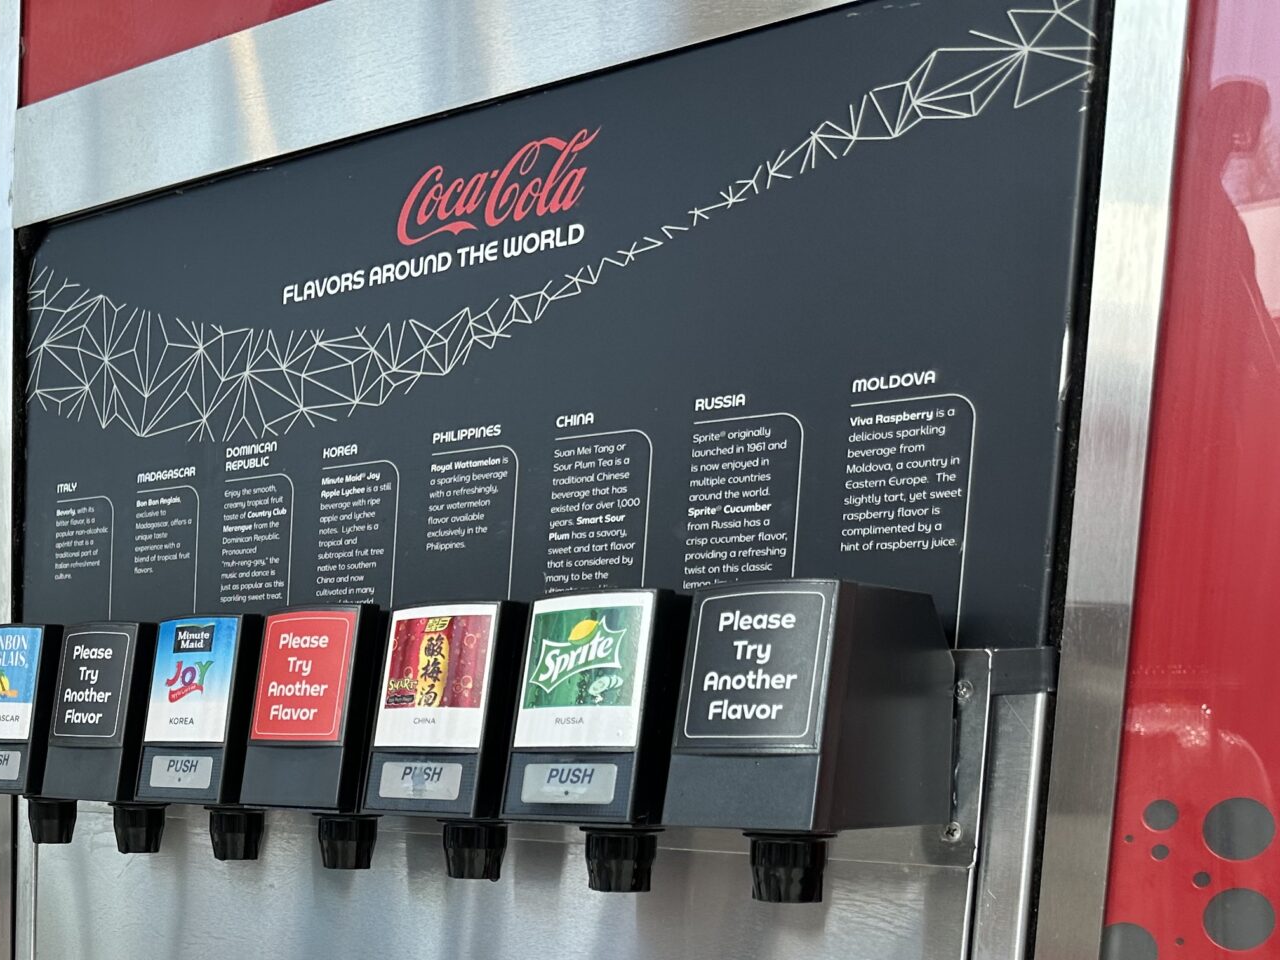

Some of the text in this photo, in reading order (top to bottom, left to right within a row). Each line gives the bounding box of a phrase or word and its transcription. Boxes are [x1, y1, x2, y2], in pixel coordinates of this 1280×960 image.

[396, 125, 602, 246] Coca-Cola
[282, 223, 585, 305] FLAVORS AROUND THE WORLD
[852, 370, 937, 393] MOLDOVA
[695, 393, 746, 411] RUSSIA
[555, 412, 594, 428] CHINA
[849, 407, 955, 427] Viva Raspberry is a
[432, 424, 502, 444] PHILIPPINES
[726, 426, 771, 441] originally
[847, 424, 946, 443] delicious sparkling
[225, 441, 278, 458] DOMINICAN
[322, 444, 358, 459] KOREA
[553, 442, 626, 458] Suan Mei Tang or
[691, 438, 787, 458] launched in 1961 and
[846, 442, 925, 458] beverage from
[225, 456, 270, 471] REPUBLIC
[552, 456, 630, 472] Sour Plum Tea is a
[690, 456, 770, 473] is now enjoyed in
[845, 455, 960, 474] Moldova, a country in
[136, 466, 196, 483] MADAGASCAR
[551, 471, 630, 486] traditional Chinese
[689, 472, 771, 487] multiple countries
[844, 471, 957, 490] Eastern Europe. The
[56, 482, 78, 494] ITALY
[550, 485, 628, 500] beverage that has
[688, 489, 723, 502] around
[723, 489, 740, 499] the
[843, 487, 962, 507] slightly tart, yet sweet
[722, 501, 772, 514] Cucumber
[842, 505, 941, 522] raspberry flavor is
[686, 517, 770, 531] from Russia has a
[840, 521, 942, 537] complimented by a
[685, 536, 708, 547] crisp
[709, 532, 756, 544] cucumber
[839, 536, 957, 552] hint of raspberry juice.
[684, 546, 787, 562] providing a refreshing
[683, 562, 773, 575] twist on this classic
[719, 611, 796, 631] Please
[177, 631, 210, 640] Minute
[279, 633, 329, 648] Please
[180, 639, 204, 649] Maid
[73, 645, 113, 660] Please
[539, 634, 612, 683] Sprite
[733, 640, 772, 665] Try
[165, 660, 215, 687] JOY
[287, 656, 312, 677] Try
[79, 667, 99, 685] Try
[703, 671, 798, 691] Another
[64, 689, 112, 704] Another
[268, 681, 329, 697] Another
[64, 710, 103, 725] Flavor
[269, 704, 318, 721] Flavor
[707, 700, 783, 720] Flavor
[168, 716, 195, 726] KOREA
[412, 717, 436, 725] CHINA
[554, 716, 584, 725] RUSSIA
[166, 759, 198, 773] PUSH
[547, 768, 593, 785] PUSH
